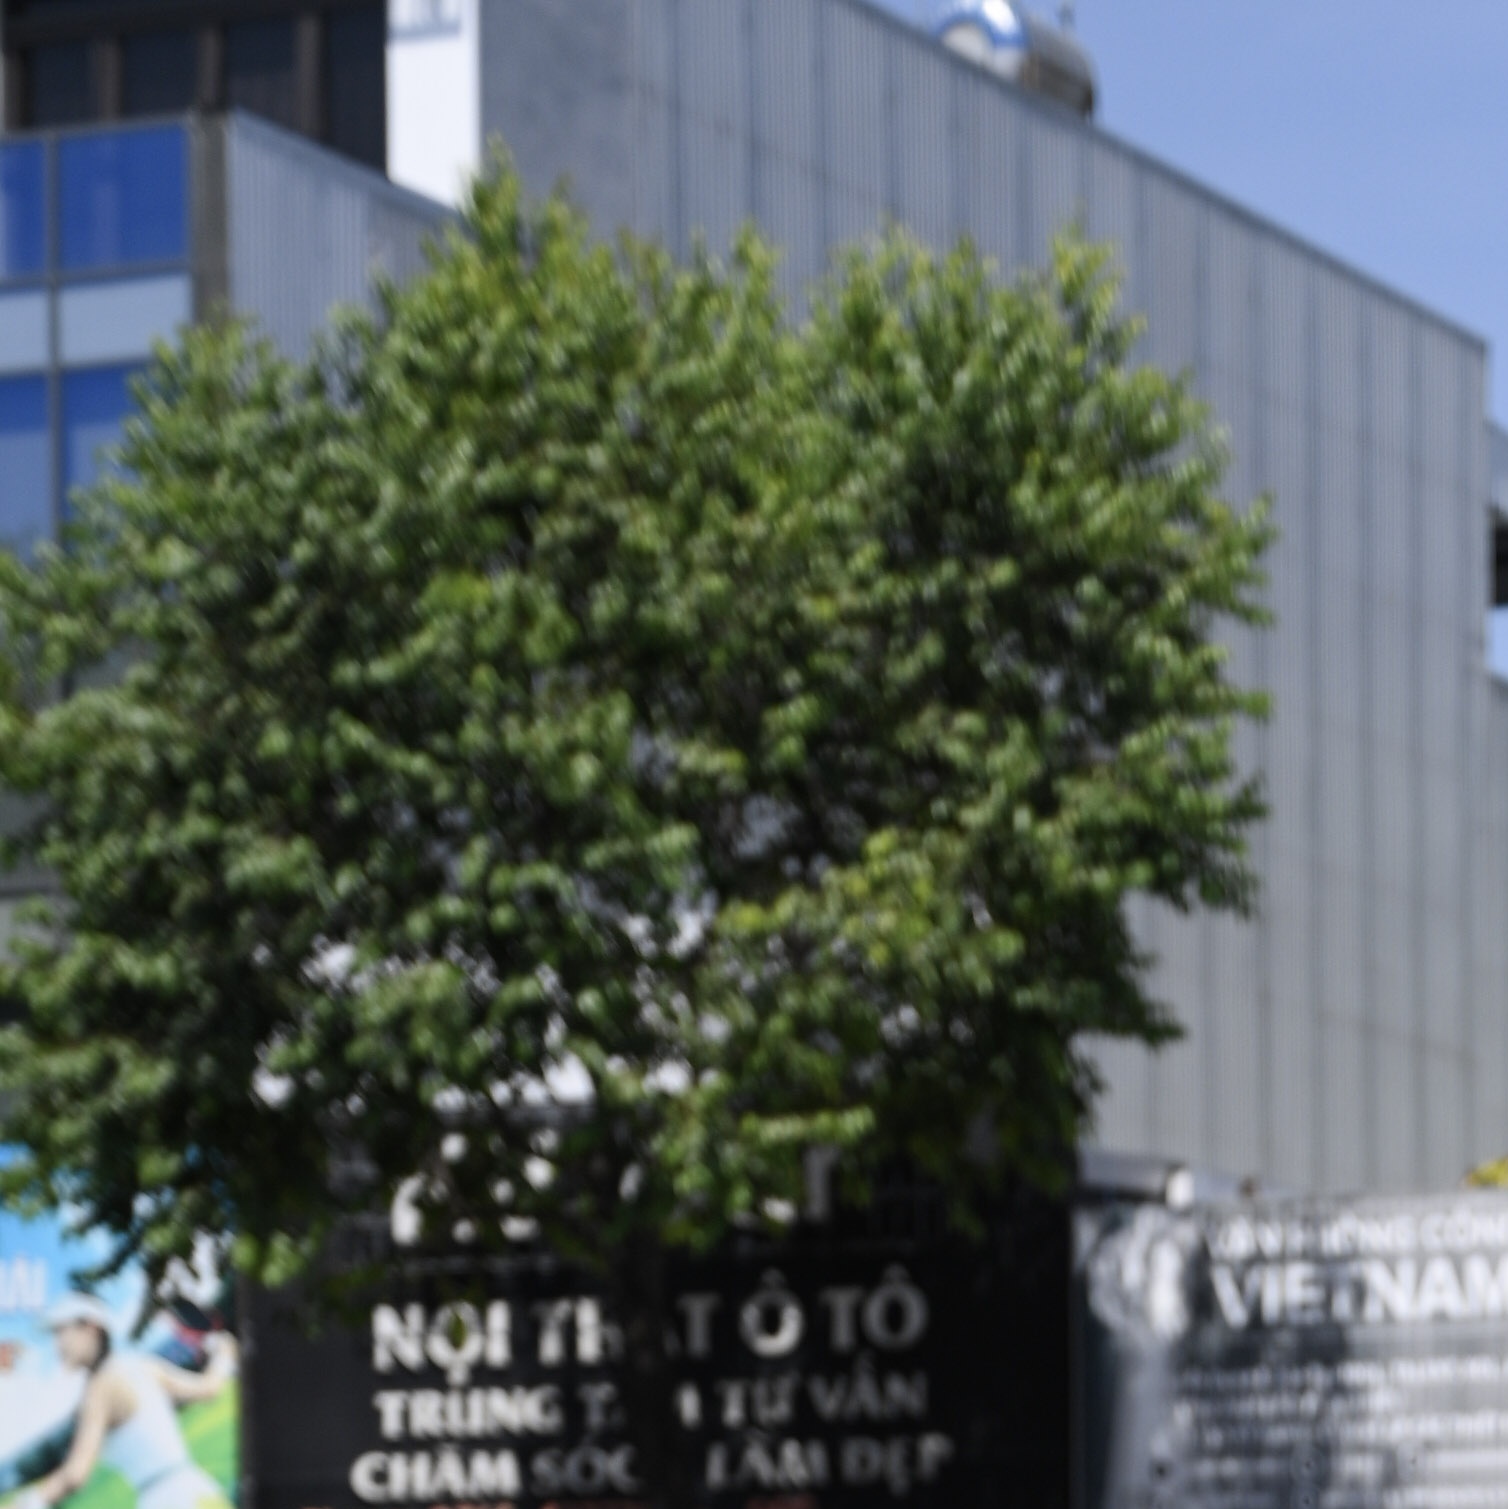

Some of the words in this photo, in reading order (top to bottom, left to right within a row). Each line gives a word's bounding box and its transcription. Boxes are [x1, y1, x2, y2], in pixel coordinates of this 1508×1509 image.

[741, 1268, 805, 1359] Ô
[818, 1263, 930, 1354] TÔ
[372, 1387, 562, 1440] TRUNG
